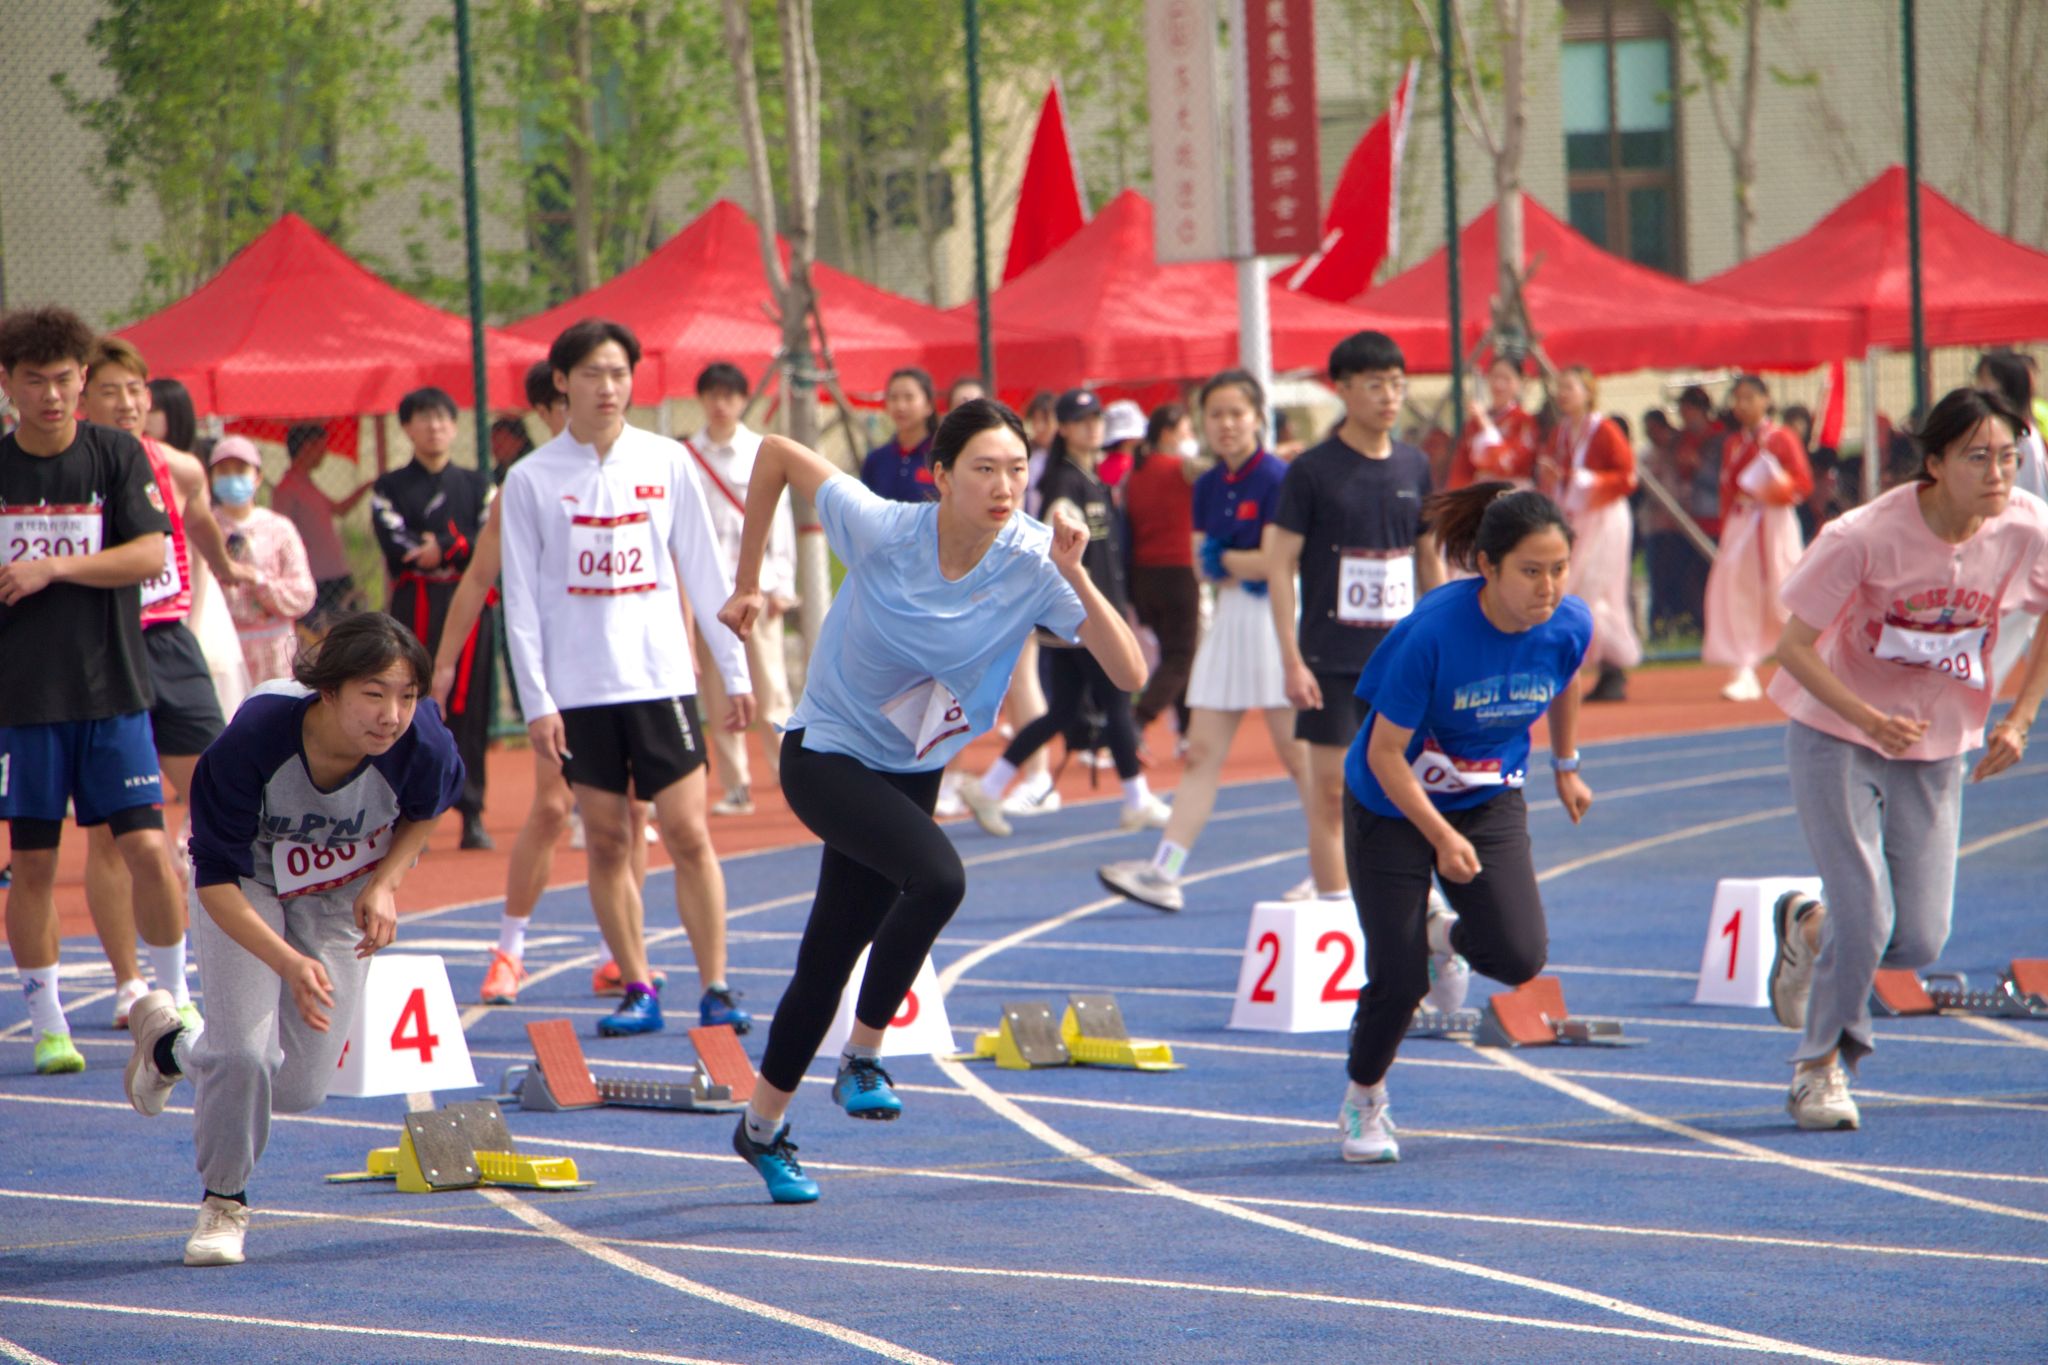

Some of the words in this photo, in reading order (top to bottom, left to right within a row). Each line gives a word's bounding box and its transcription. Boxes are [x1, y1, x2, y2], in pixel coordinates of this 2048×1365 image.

[578, 548, 644, 577] 0402
[1453, 675, 1505, 711] WEST
[1249, 932, 1280, 1002] 2
[1316, 931, 1361, 1002] 2
[1722, 909, 1742, 981] 1
[390, 988, 439, 1063] 4
